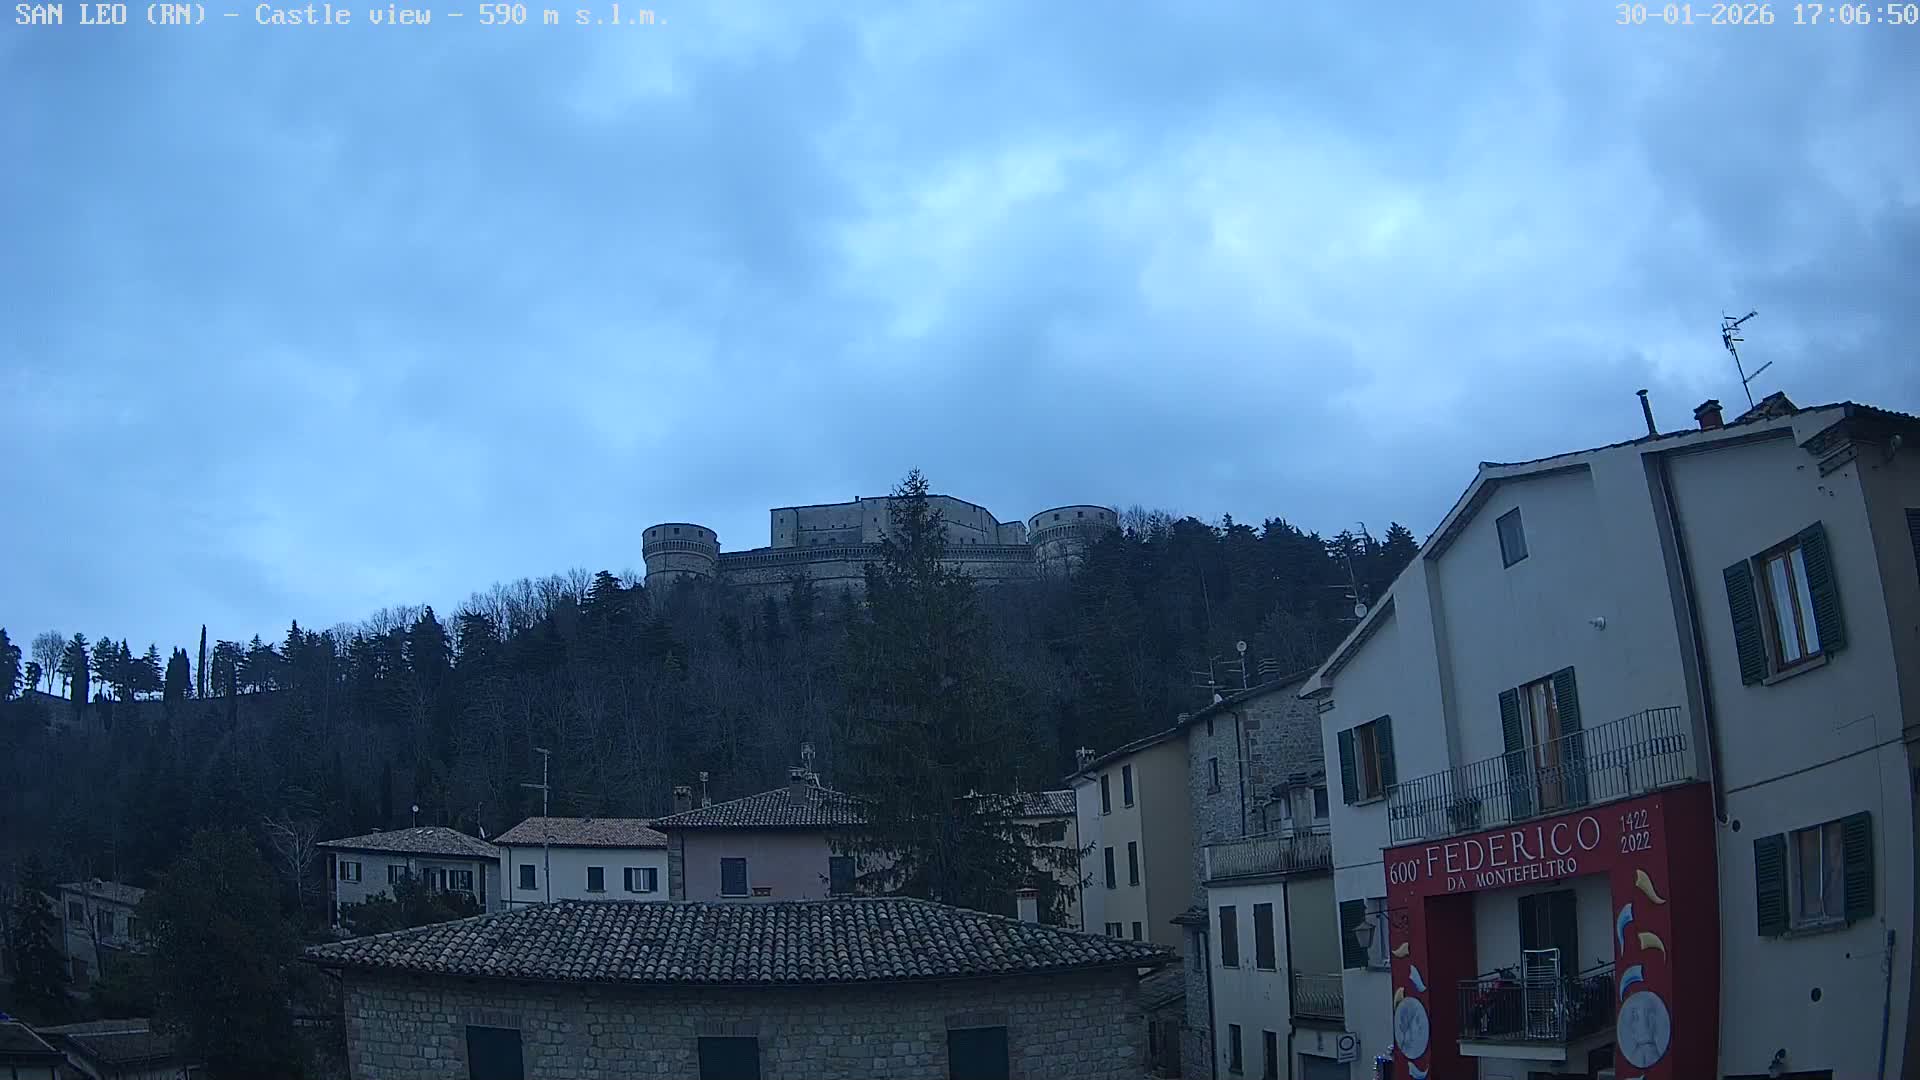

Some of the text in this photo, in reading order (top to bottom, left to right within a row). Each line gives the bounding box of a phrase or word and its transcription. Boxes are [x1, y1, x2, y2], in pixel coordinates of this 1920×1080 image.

[1620, 809, 1649, 831] 1422
[1425, 816, 1601, 877] FEDERICO
[1621, 832, 1652, 854] 2022
[1447, 857, 1578, 892] DA MONTEFELTRO
